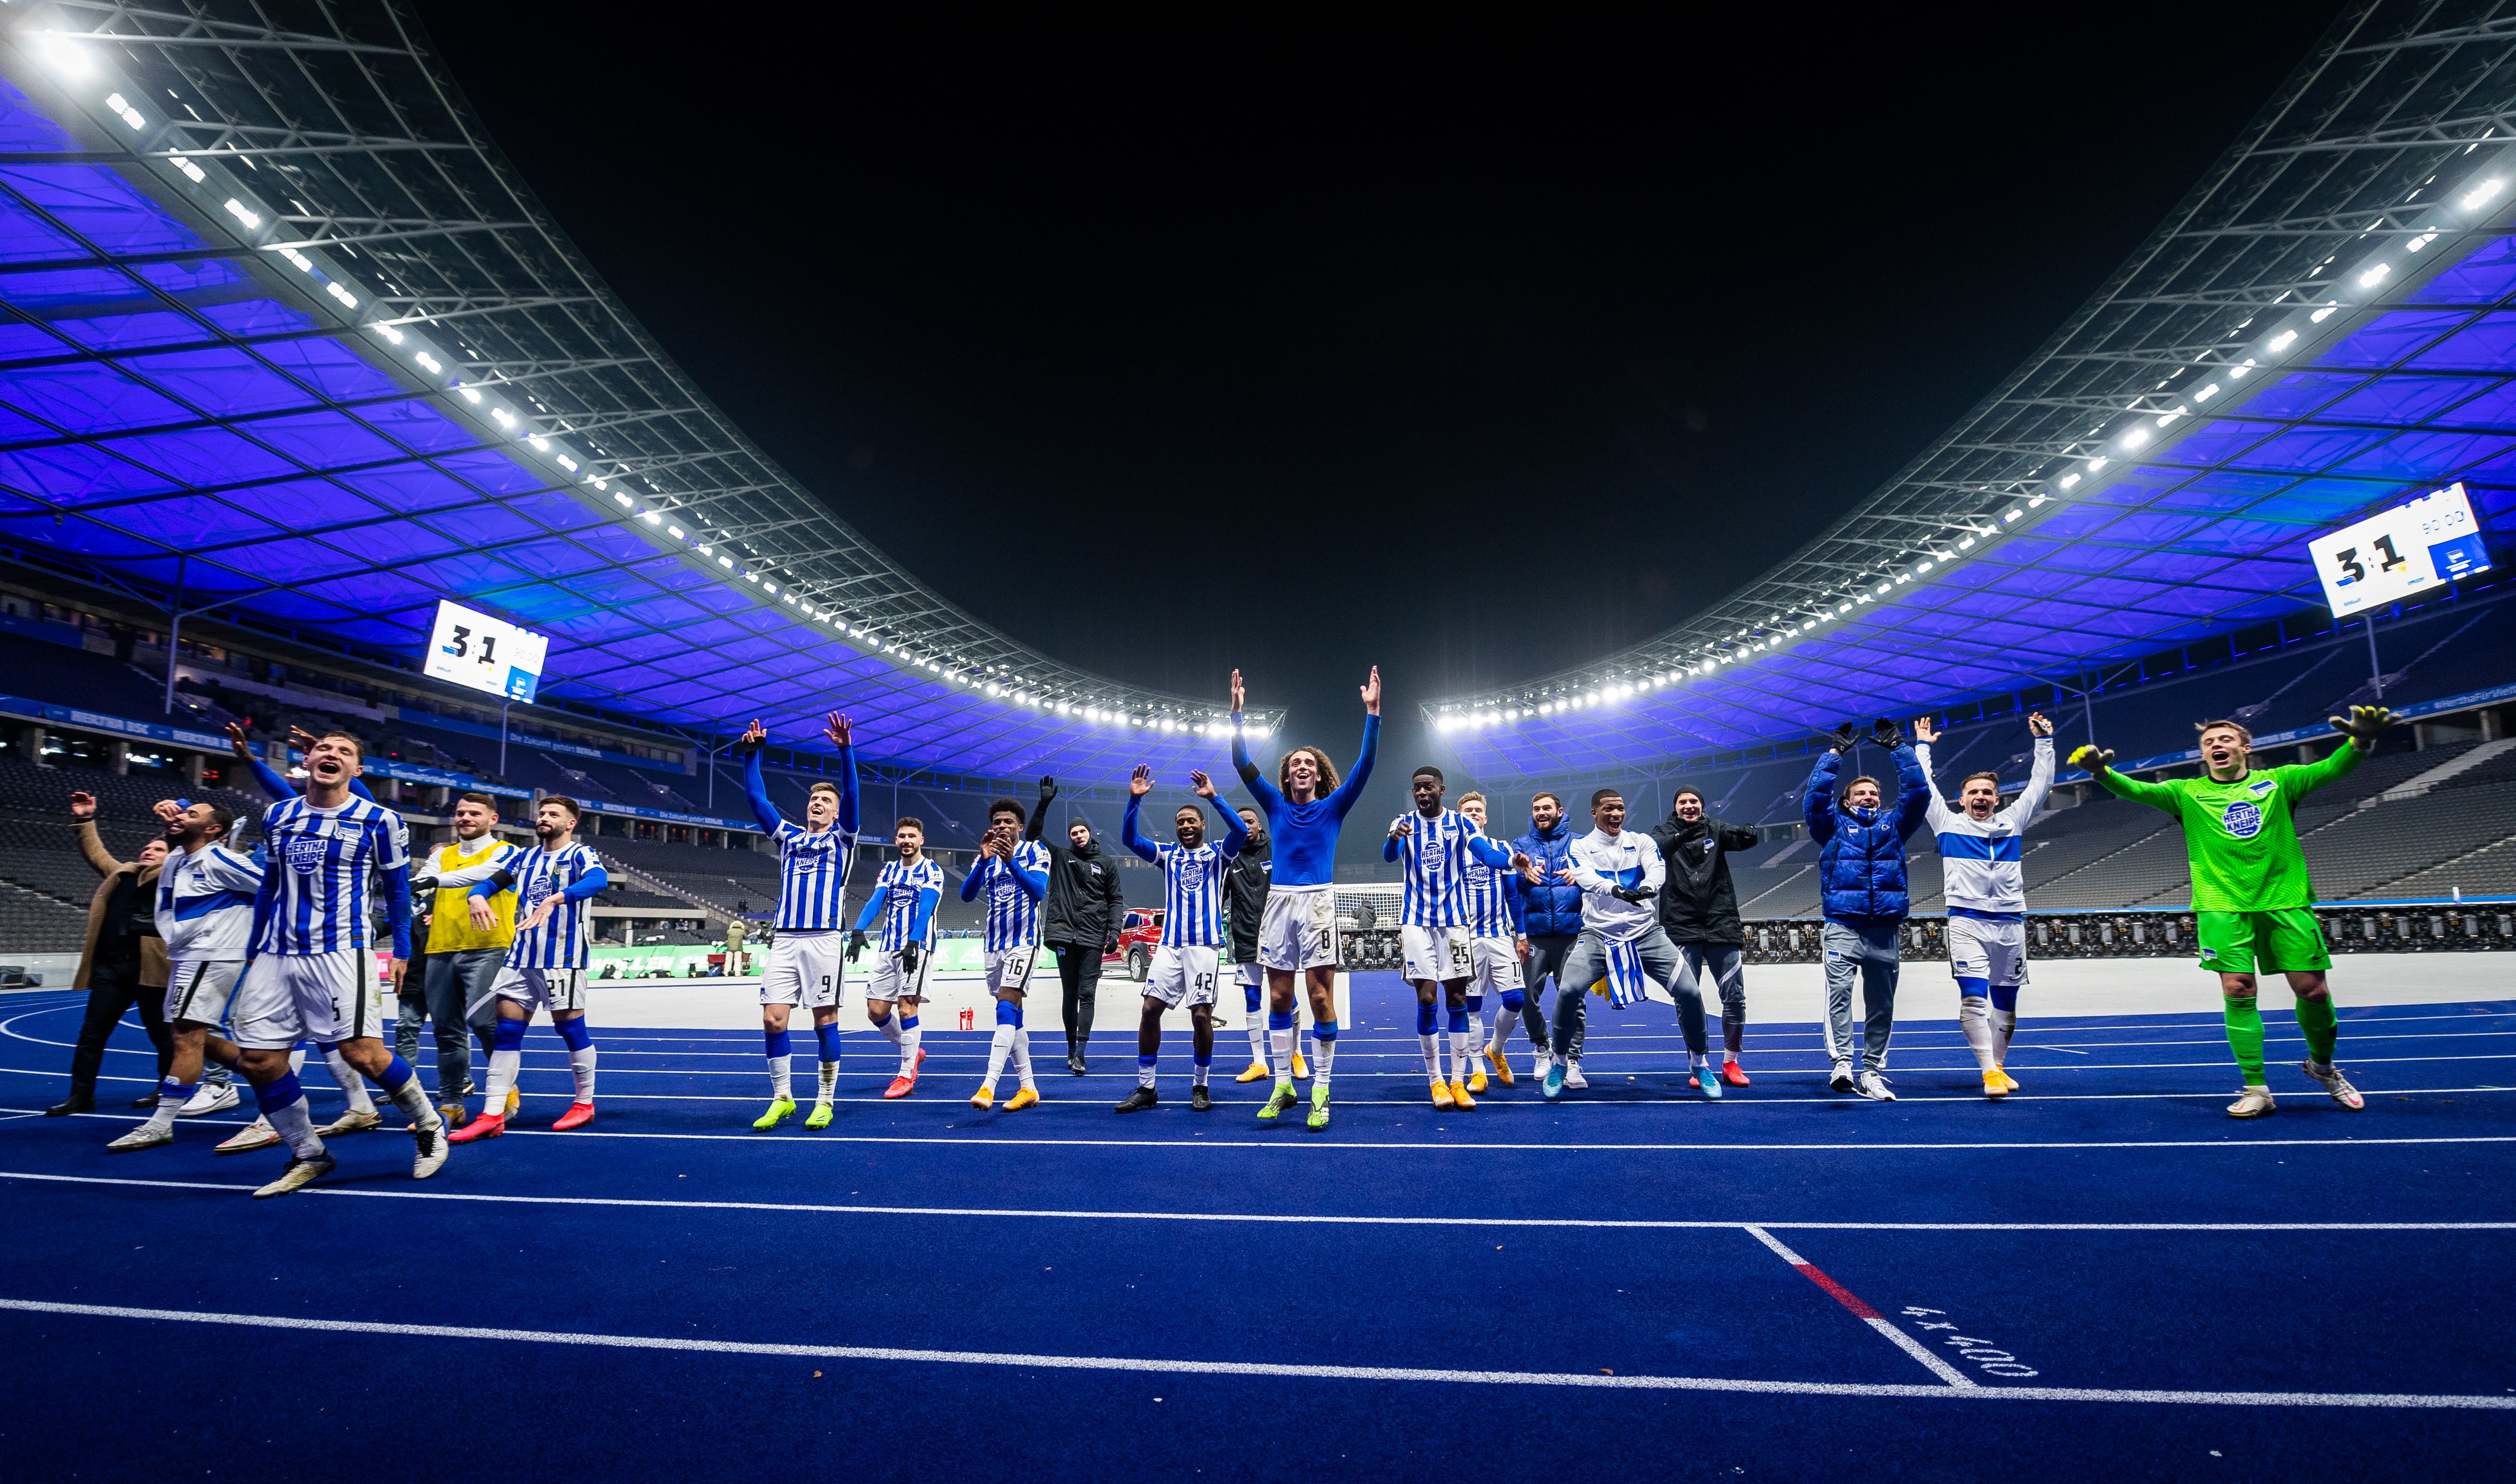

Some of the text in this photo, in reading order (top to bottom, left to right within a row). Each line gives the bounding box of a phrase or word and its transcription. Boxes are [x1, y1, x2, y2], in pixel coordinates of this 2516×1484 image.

[510, 733, 522, 742] Die
[523, 736, 551, 748] Zukunft
[2223, 807, 2260, 824] HERTHA
[2227, 816, 2262, 831] KNEIPE
[286, 841, 325, 854] HERTHA
[1421, 847, 1445, 858] HERTHA
[796, 856, 819, 866] KNEIPE
[1422, 855, 1445, 865] KNEIPE
[1181, 867, 1203, 879] HERTHA
[1467, 867, 1489, 878] HERTHA
[528, 882, 551, 894] HERTHA
[995, 878, 1015, 890] HERTHA
[1182, 876, 1203, 886] KNEIPE
[1321, 930, 1330, 949] 8
[2311, 928, 2322, 949] 1
[1452, 946, 1469, 964] 25
[589, 956, 676, 971] WOLLEN
[1008, 958, 1025, 976] 16
[2014, 957, 2022, 975] 2
[546, 979, 565, 997] 21
[822, 975, 831, 994] 9
[1195, 972, 1212, 991] 42
[332, 996, 341, 1022] 5
